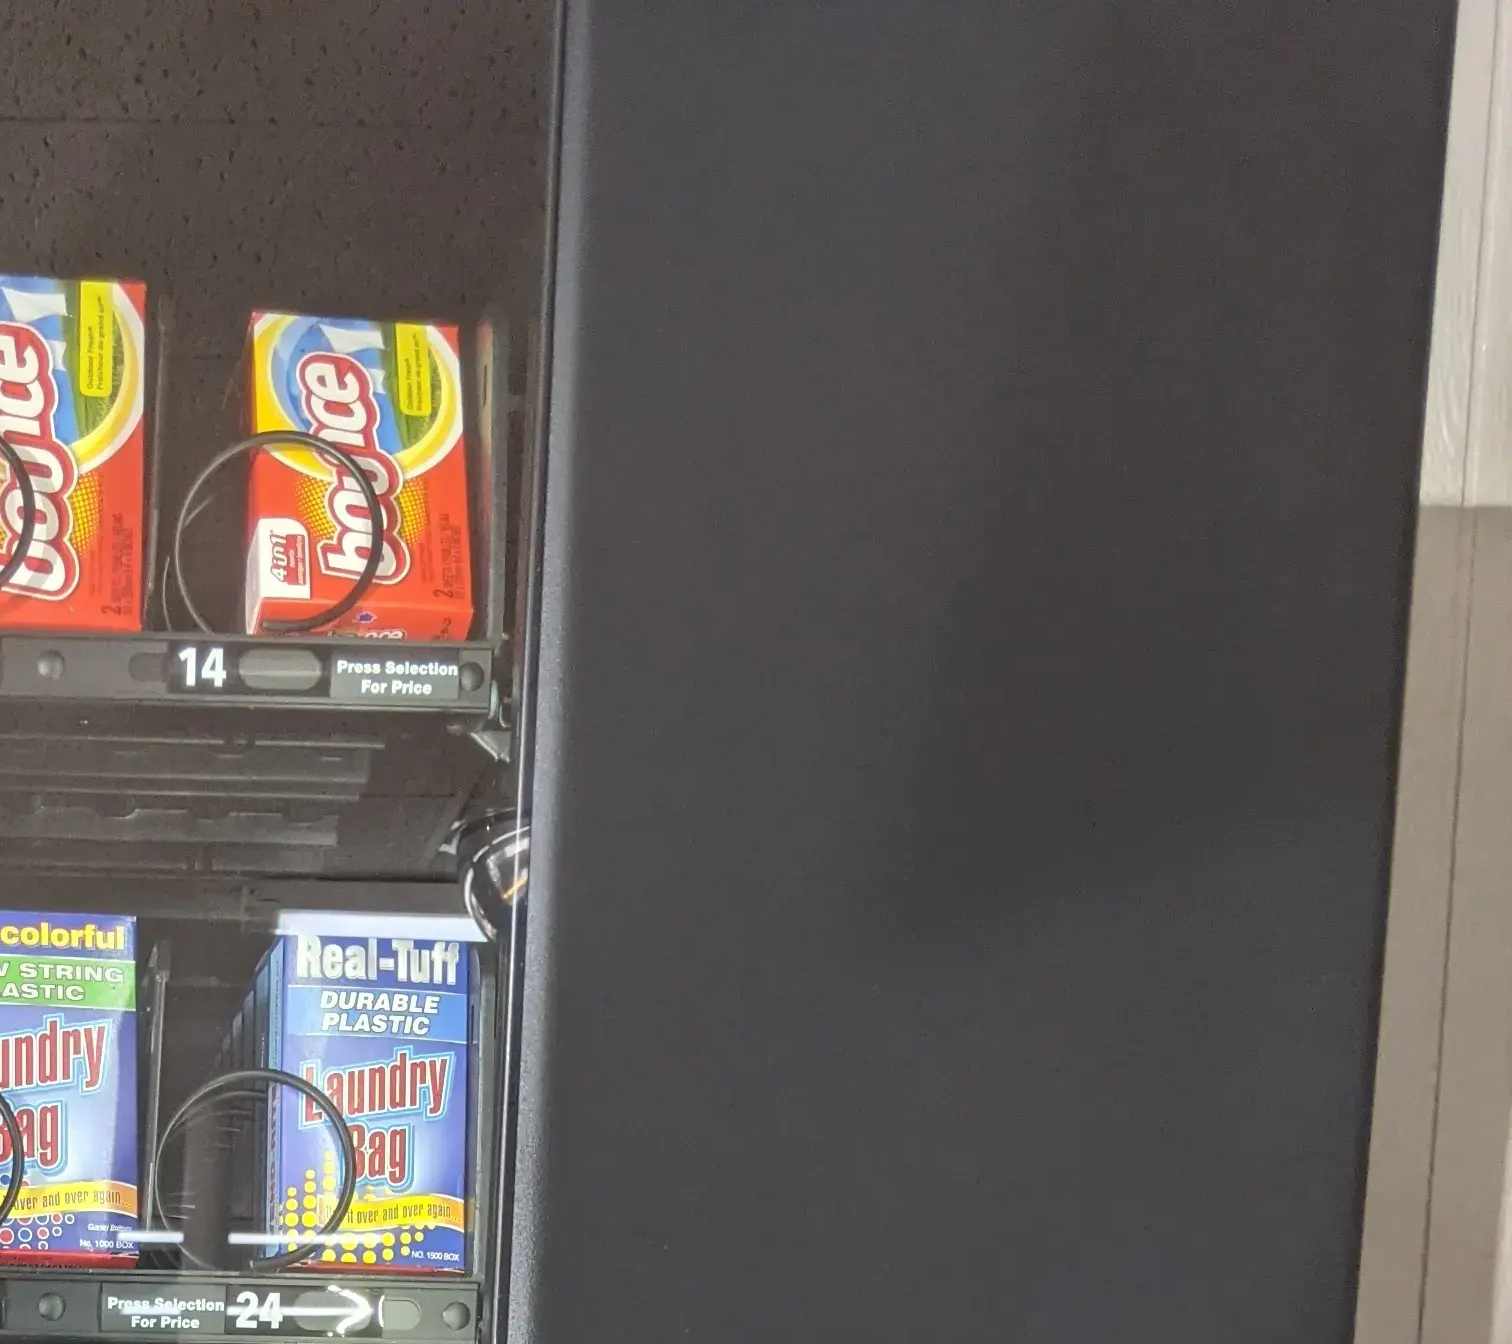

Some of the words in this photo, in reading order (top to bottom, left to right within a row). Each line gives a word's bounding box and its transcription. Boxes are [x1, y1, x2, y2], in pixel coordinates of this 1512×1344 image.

[302, 360, 401, 580] bounce
[178, 647, 226, 687] 14
[337, 660, 381, 676] Press
[386, 661, 458, 677] Selection
[361, 679, 389, 694] For
[393, 680, 432, 695] Price
[0, 923, 125, 950] colorful
[19, 962, 124, 983] STRING
[297, 934, 459, 985] Real-Tuff
[320, 991, 439, 1014] DURABLE
[322, 1013, 430, 1034] PLASTIC
[302, 1052, 448, 1123] Laundry
[350, 1123, 408, 1184] Bag
[235, 1293, 282, 1329] 24
